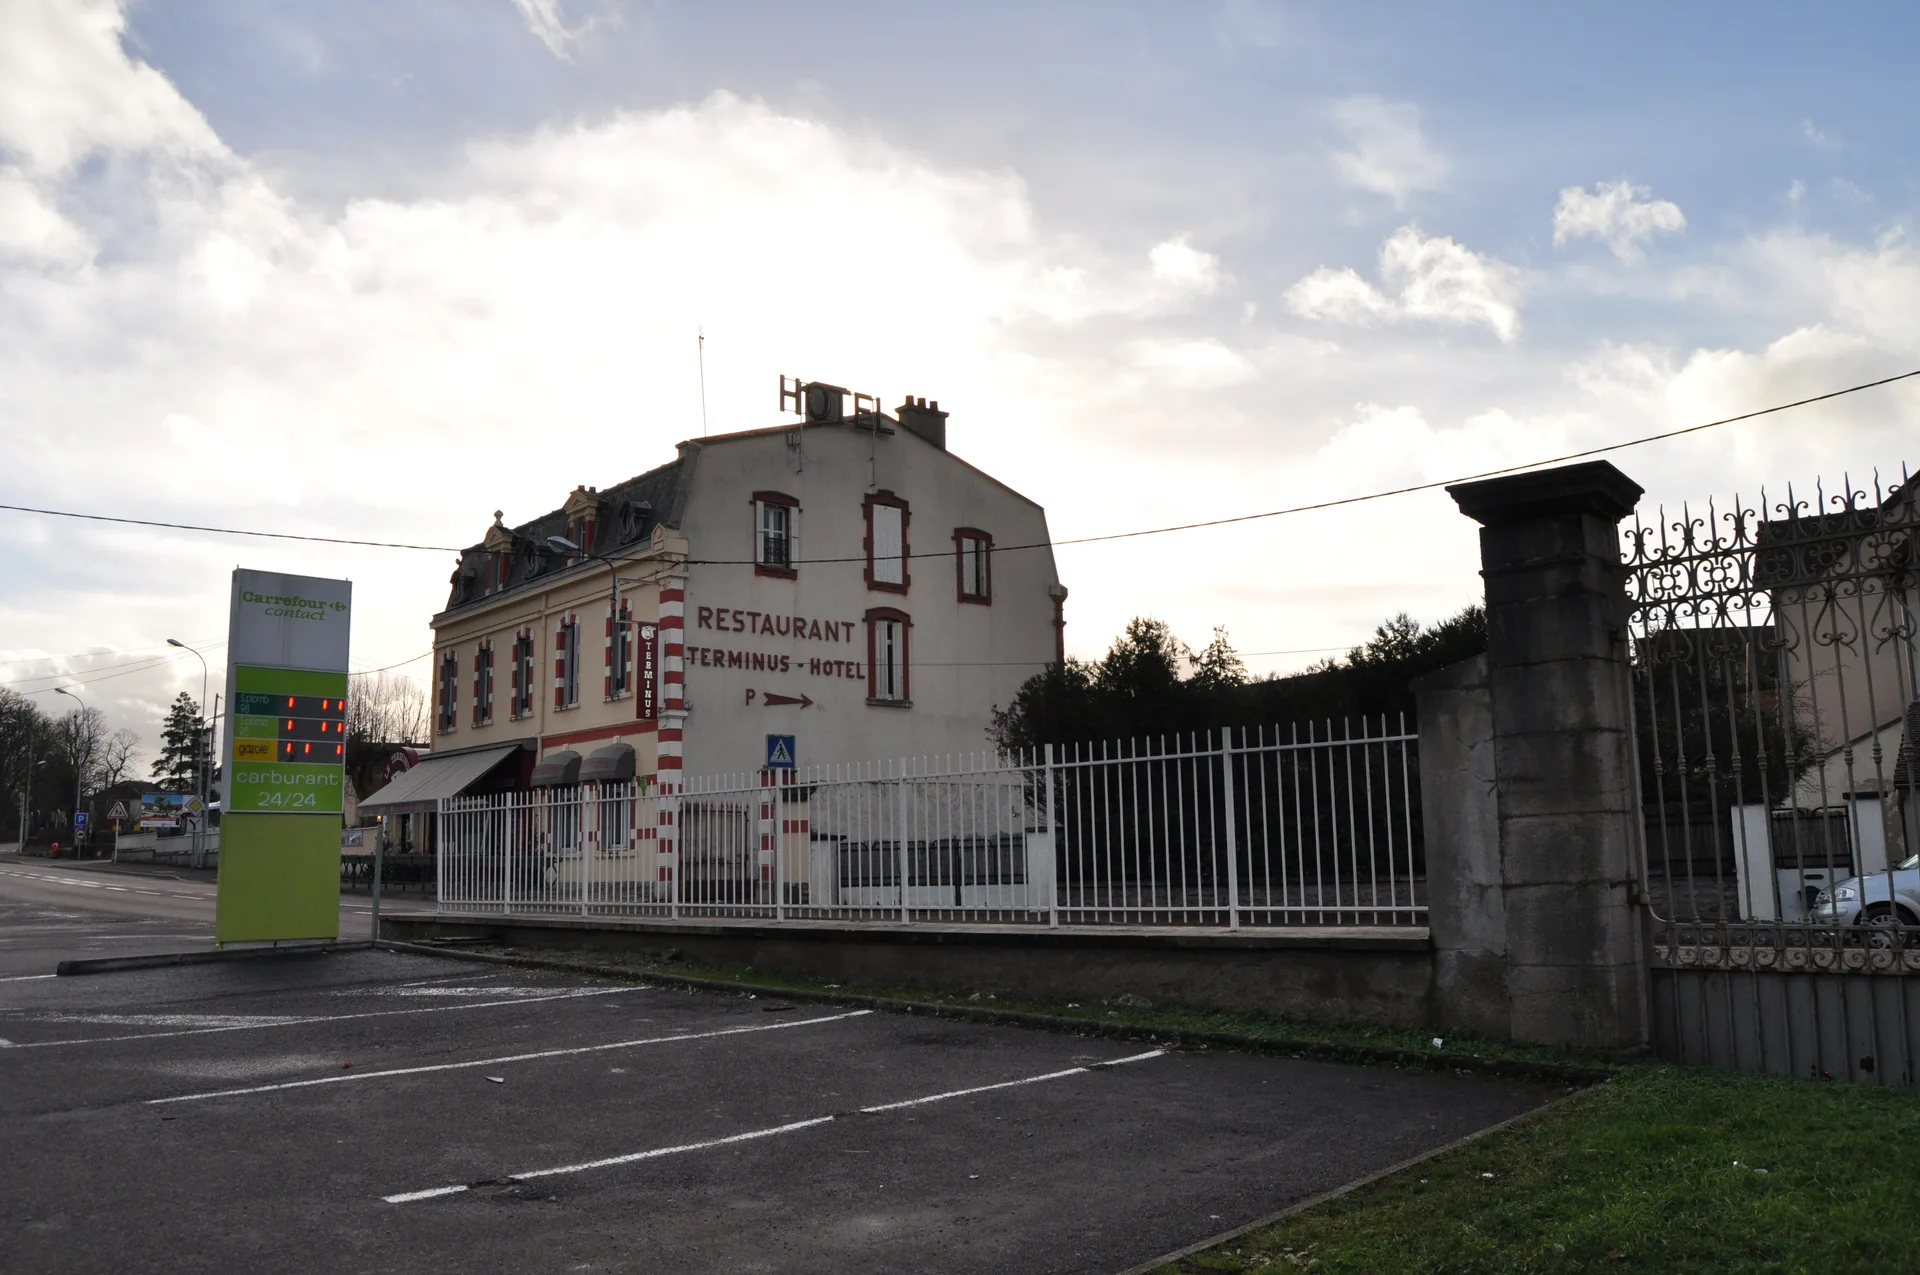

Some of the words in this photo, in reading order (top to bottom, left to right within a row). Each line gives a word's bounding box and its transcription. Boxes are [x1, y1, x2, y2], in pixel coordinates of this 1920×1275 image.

[780, 374, 895, 436] HOTEL
[242, 591, 328, 609] Carrefour
[265, 607, 326, 621] contact
[698, 606, 855, 643] RESTAURANT
[687, 646, 790, 673] TERMINUS
[810, 657, 866, 680] HOTEL
[643, 641, 653, 718] TERMINUS
[238, 743, 269, 756] gazole
[236, 770, 339, 786] carburant
[257, 791, 317, 808] 24/24
